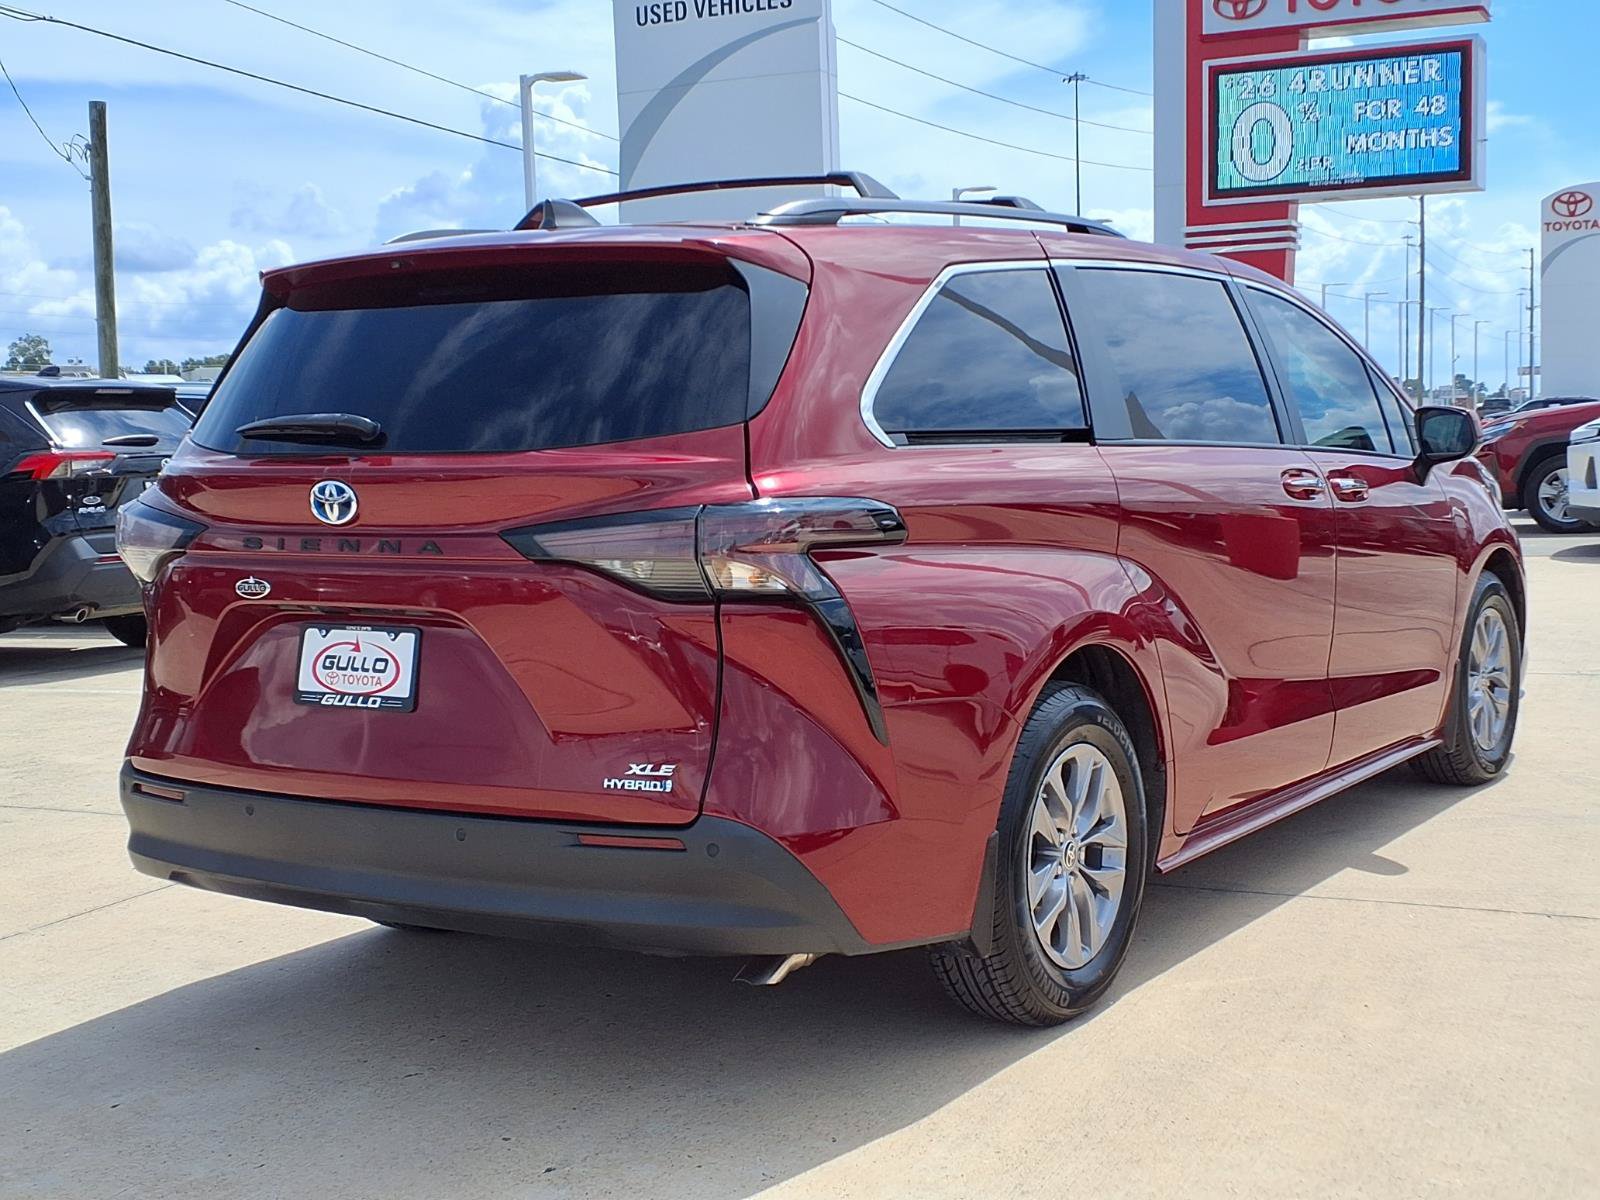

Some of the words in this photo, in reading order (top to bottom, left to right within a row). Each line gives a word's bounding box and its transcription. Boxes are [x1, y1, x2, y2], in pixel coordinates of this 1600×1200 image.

[636, 1, 687, 26] USED
[1288, 58, 1443, 94] 4RUNNER
[1354, 98, 1402, 121] FOR
[1413, 95, 1446, 116] 48
[1346, 126, 1453, 154] MONTHS
[1544, 219, 1600, 232] TOYOTA
[242, 537, 443, 554] SIENNA
[238, 583, 267, 593] GULLO
[322, 655, 389, 673] GULLO
[342, 674, 382, 686] TOYOTA
[321, 694, 381, 708] GULLO
[624, 764, 677, 776] XLE
[603, 778, 664, 792] HYBRID
